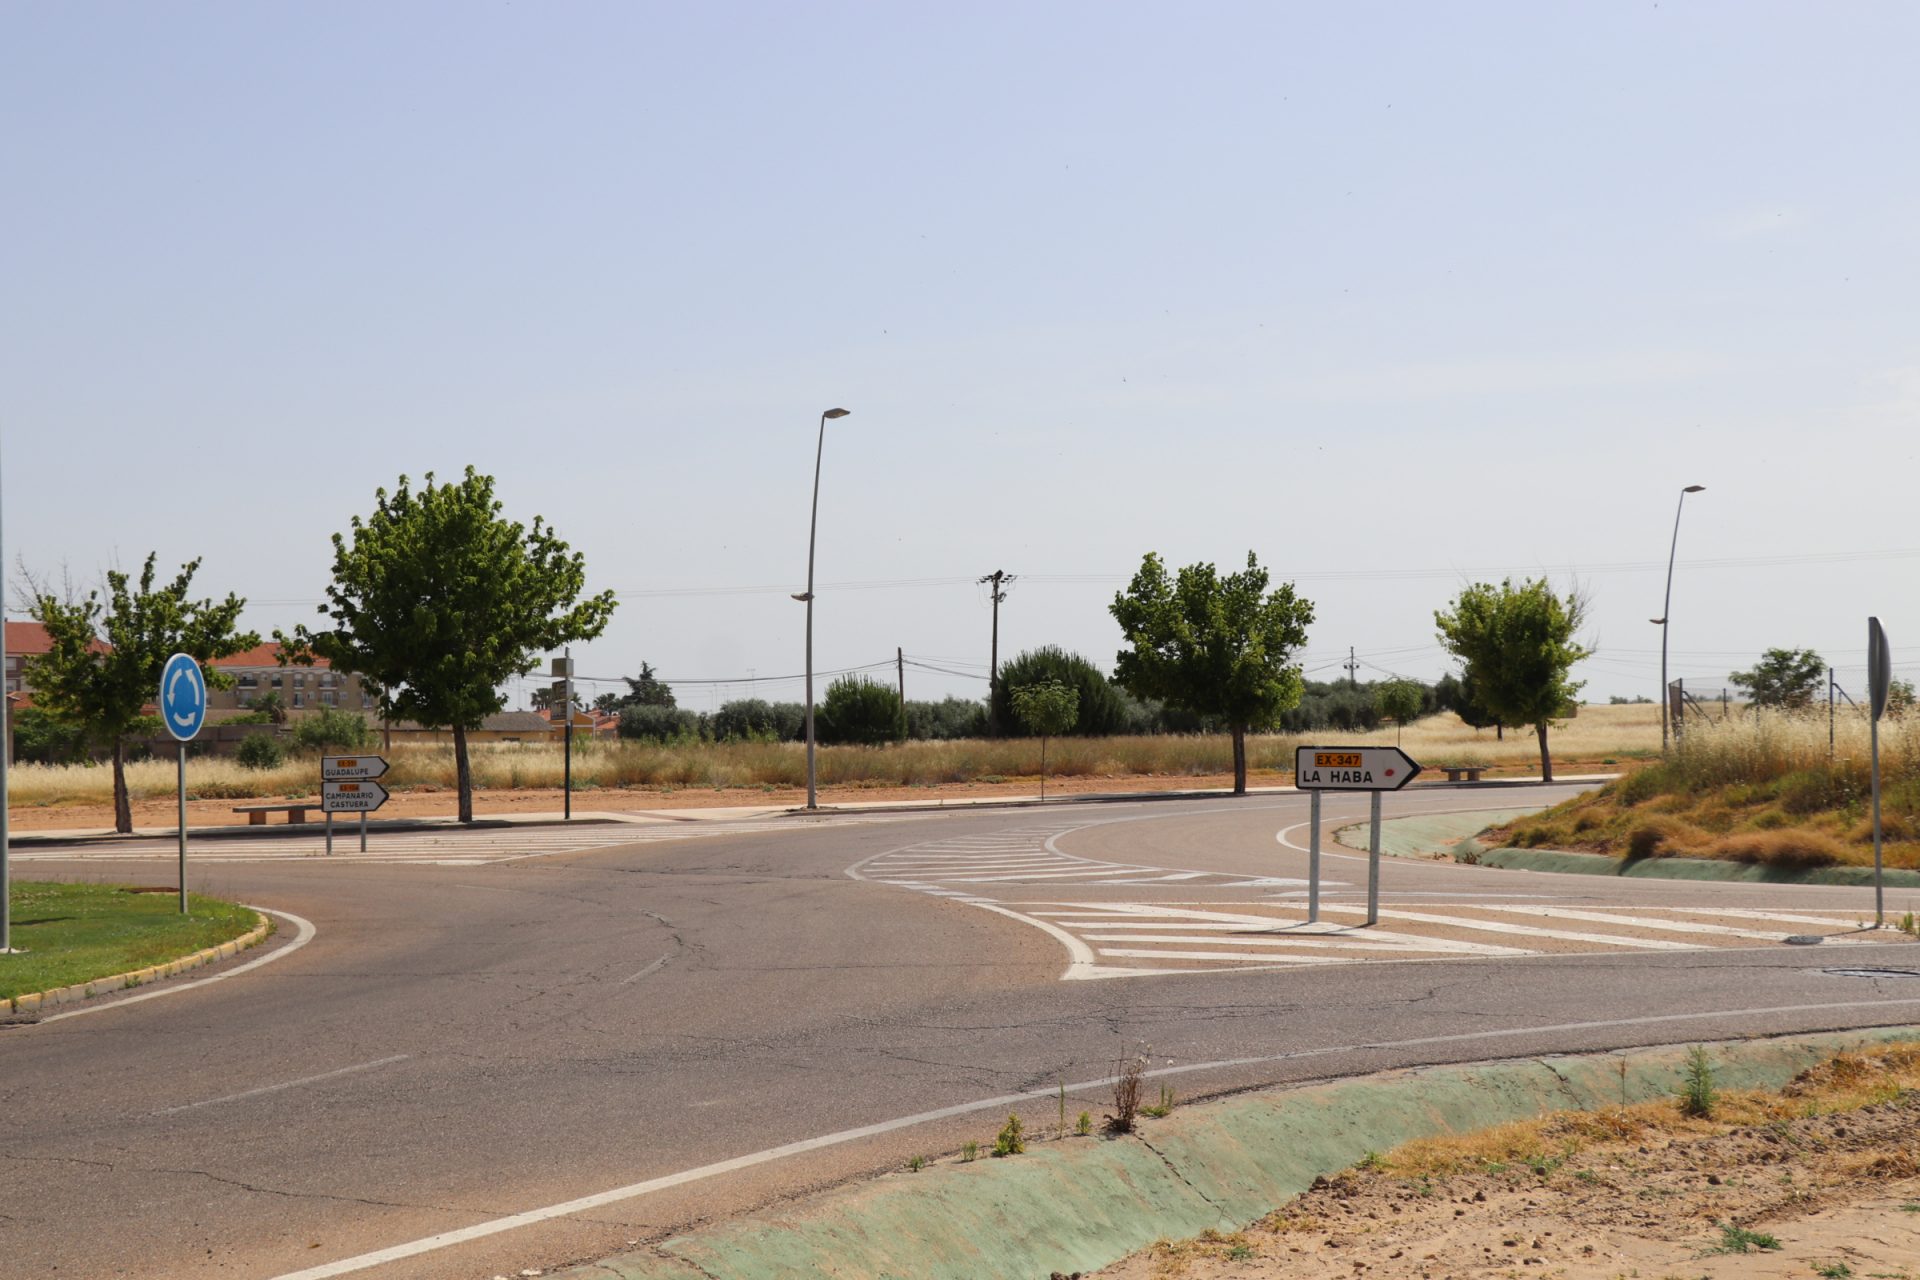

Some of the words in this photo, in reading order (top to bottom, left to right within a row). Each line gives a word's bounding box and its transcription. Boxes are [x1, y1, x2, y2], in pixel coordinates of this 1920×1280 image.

[1316, 755, 1360, 765] EX-347
[325, 768, 369, 776] GUADALUPE
[1303, 770, 1321, 783] LA
[1330, 771, 1373, 783] HABA
[326, 792, 374, 800] CAMPANARIO
